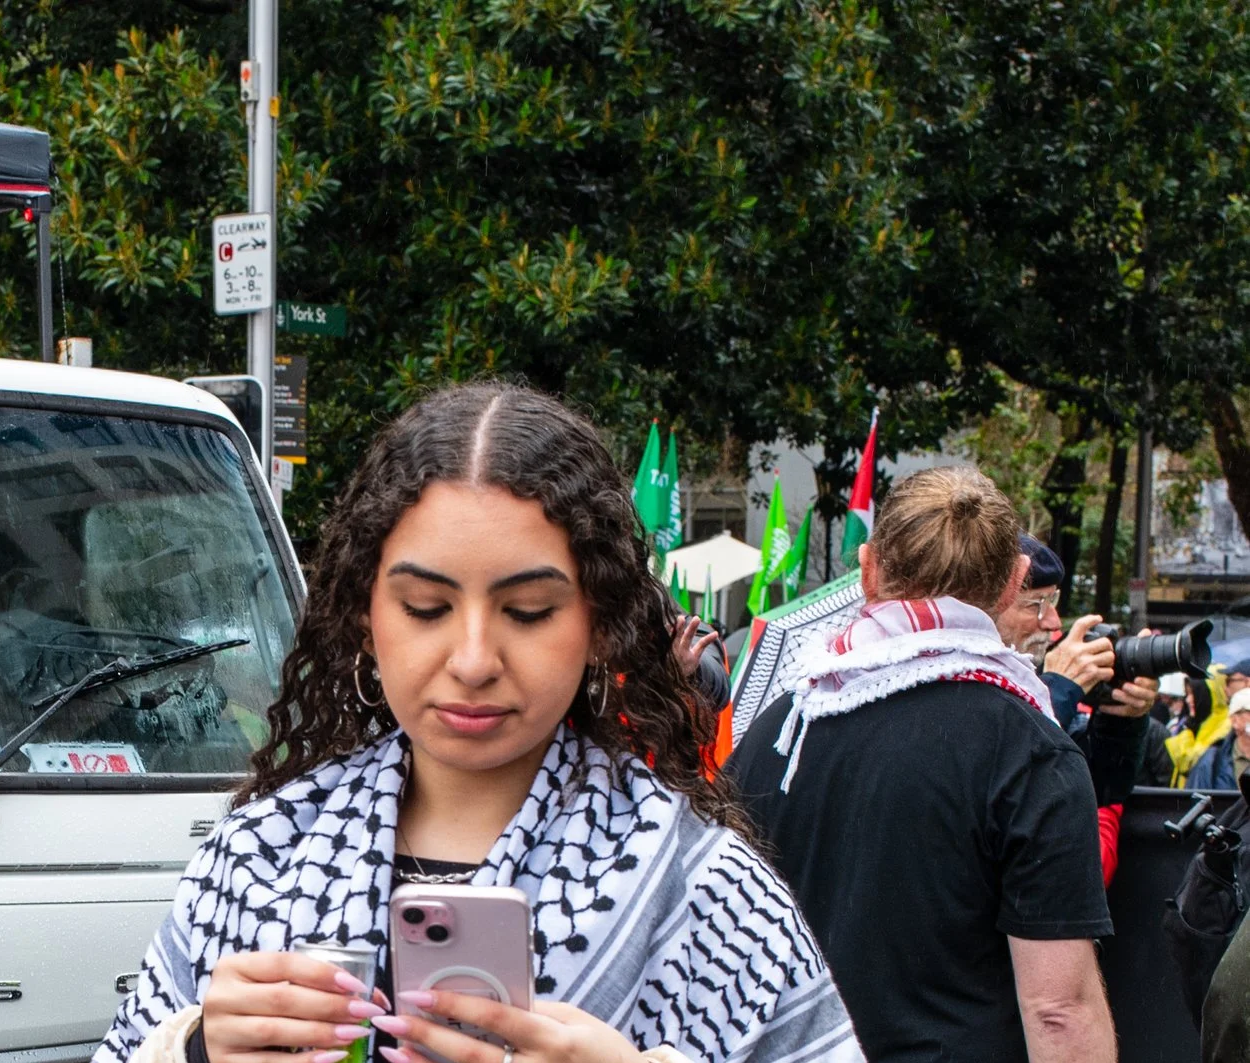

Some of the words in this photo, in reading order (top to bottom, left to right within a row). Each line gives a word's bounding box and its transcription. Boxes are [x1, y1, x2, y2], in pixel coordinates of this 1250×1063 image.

[218, 221, 266, 236] CLEARWAY
[290, 304, 314, 323] York
[316, 307, 326, 324] St
